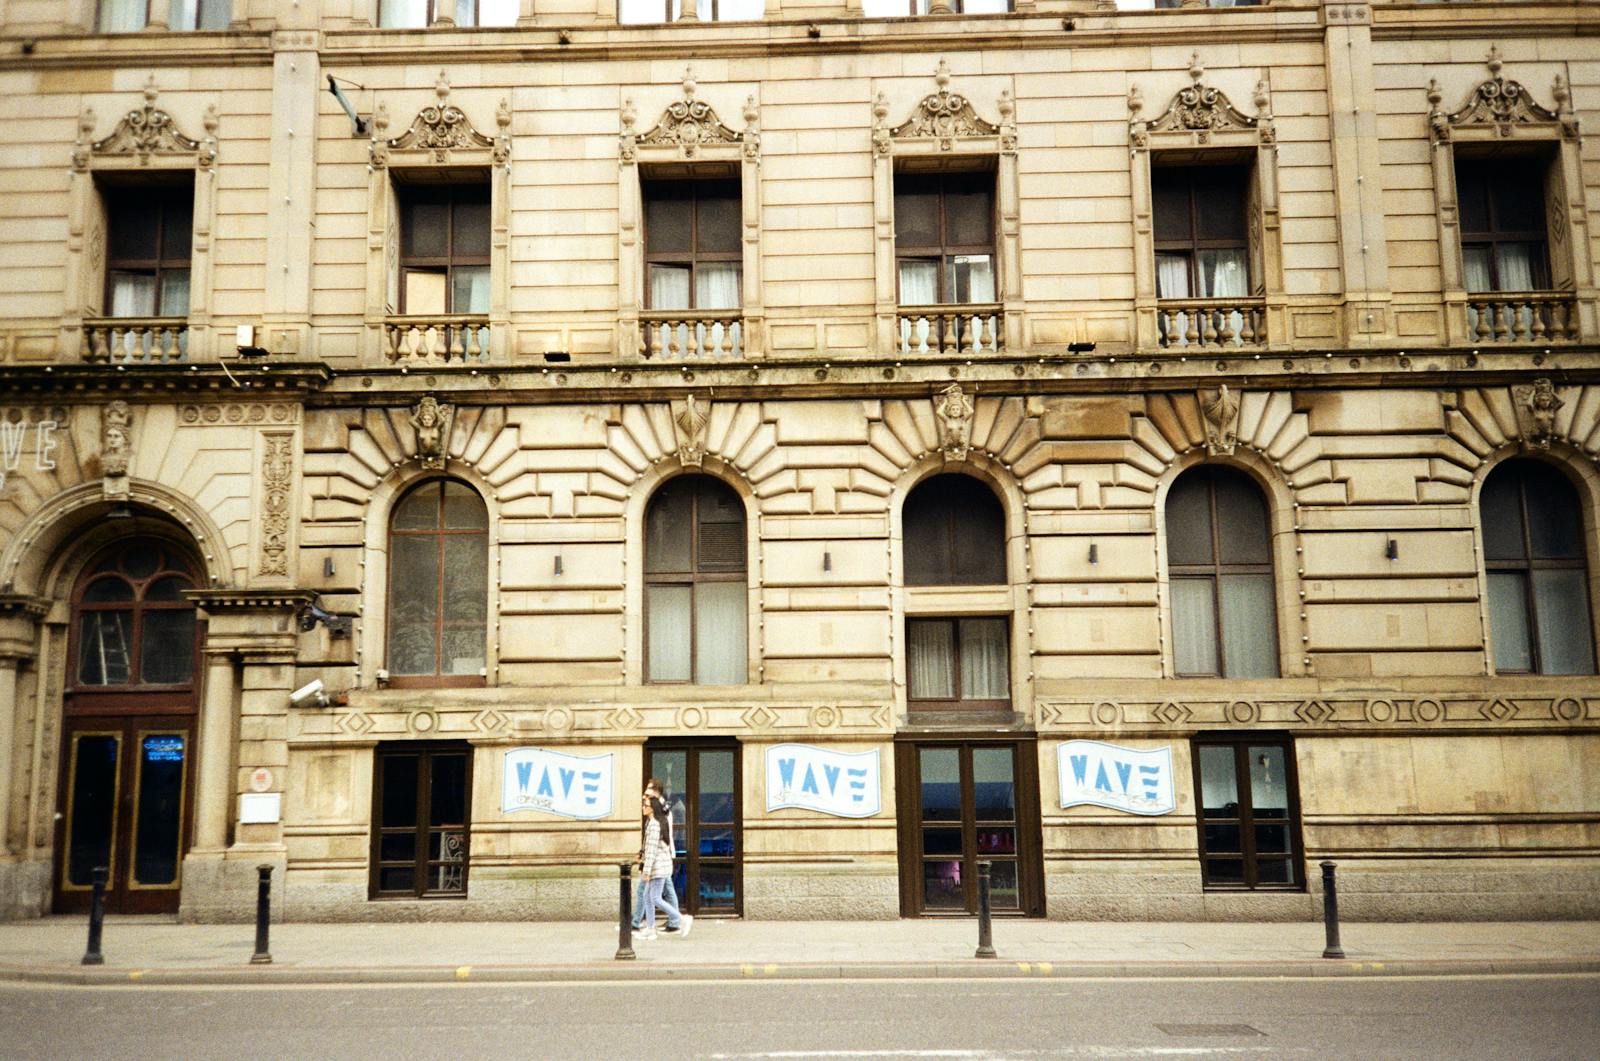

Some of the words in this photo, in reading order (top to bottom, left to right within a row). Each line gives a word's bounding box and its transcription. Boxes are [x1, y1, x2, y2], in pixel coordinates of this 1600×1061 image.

[2, 420, 57, 470] VE
[516, 761, 601, 804] WAVE
[778, 758, 867, 802] WAVE
[1069, 754, 1159, 799] WAVE
